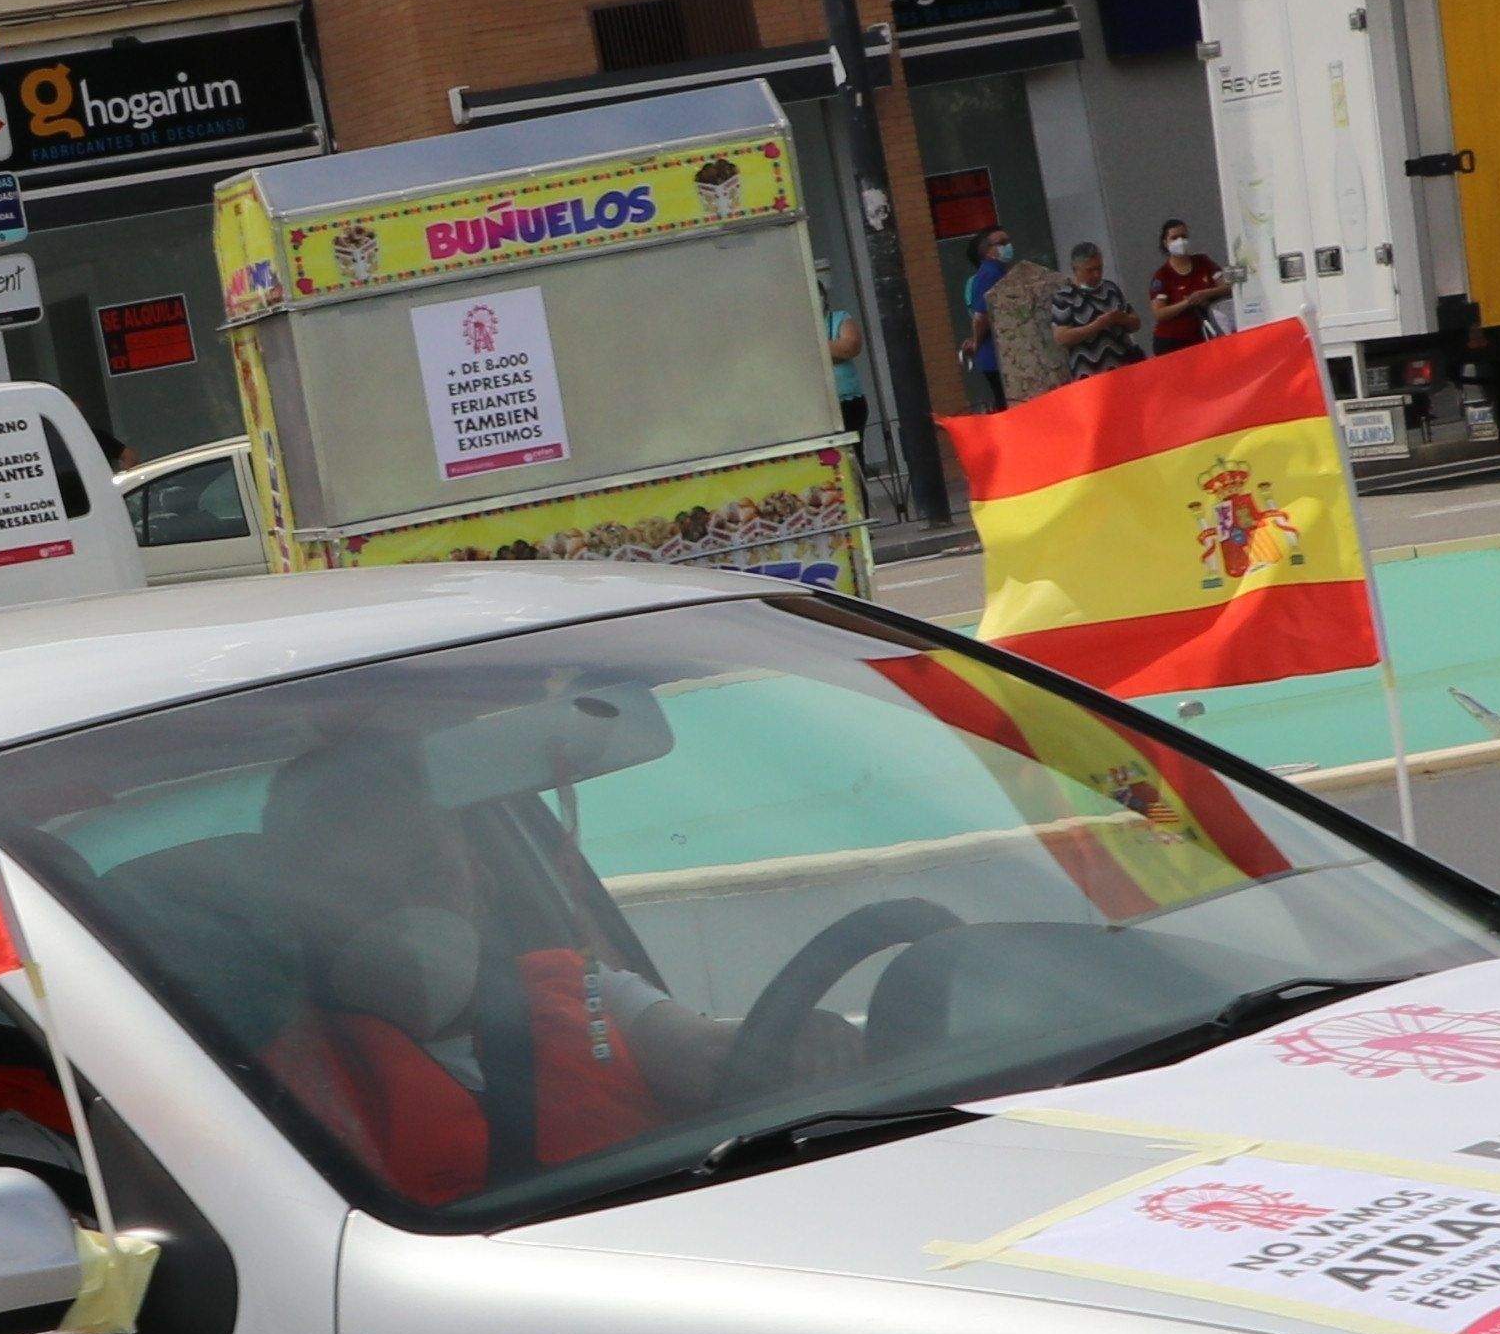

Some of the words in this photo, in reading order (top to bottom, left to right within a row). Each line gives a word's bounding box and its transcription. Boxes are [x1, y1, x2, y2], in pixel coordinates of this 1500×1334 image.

[1221, 69, 1282, 94] REYES
[80, 71, 242, 130] hogarium
[32, 134, 134, 162] FABRICANTES
[140, 131, 157, 145] DE
[167, 117, 247, 143] DESCANSO
[426, 185, 657, 261] BUÑUELOS
[447, 369, 534, 397] EMPRESAS
[462, 362, 480, 376] DE
[451, 388, 537, 417] FERIANTES
[454, 406, 539, 435] TAMBIEN
[458, 425, 543, 453] EXISTIMOS
[1229, 1242, 1302, 1272] NO
[1293, 1188, 1436, 1240] VAMOS
[1302, 1231, 1372, 1267] DEJAR
[1415, 1264, 1457, 1285] LOS
